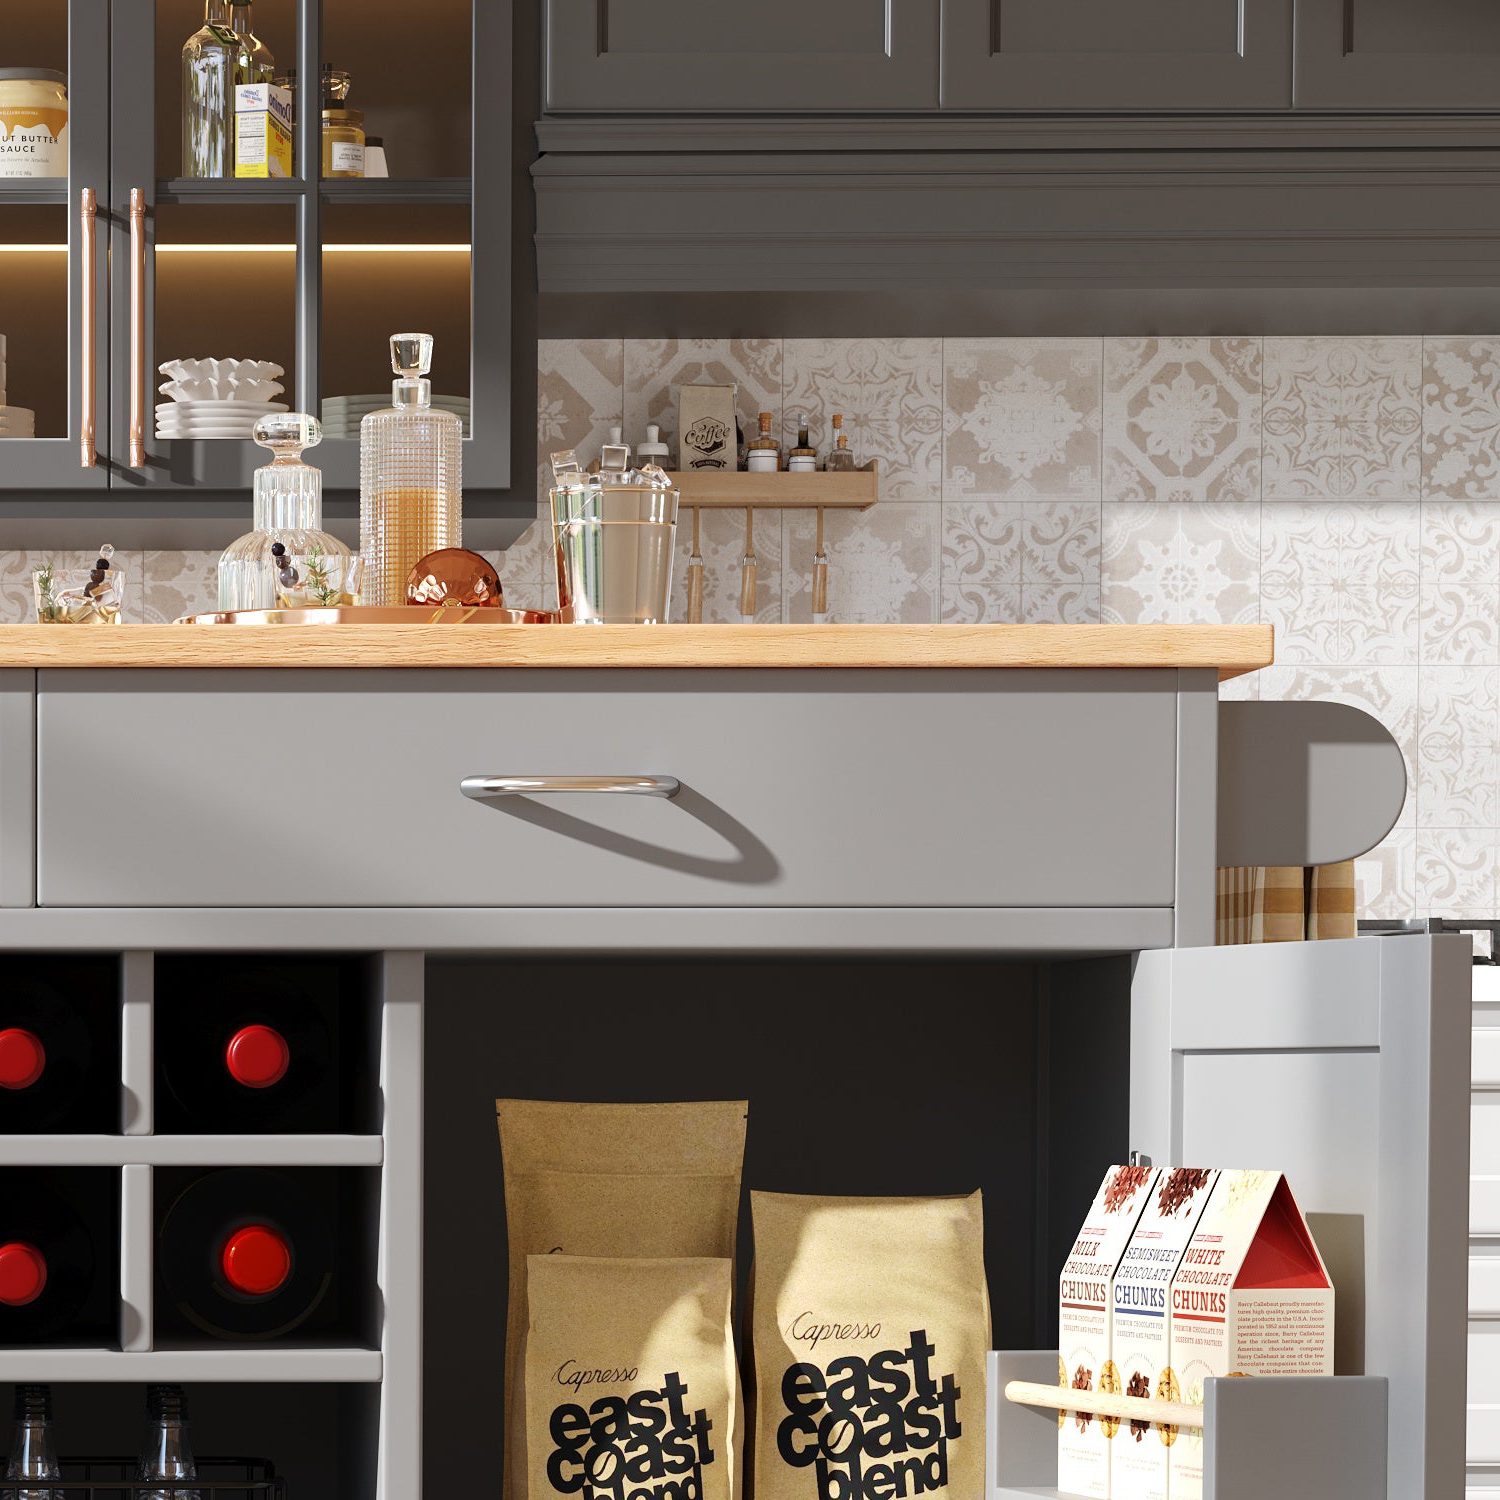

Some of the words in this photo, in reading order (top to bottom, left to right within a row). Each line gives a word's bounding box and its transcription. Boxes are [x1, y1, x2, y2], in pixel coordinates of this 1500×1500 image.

[21, 135, 58, 144] BUTTER
[685, 424, 731, 446] Coffee
[1072, 1241, 1100, 1256] MILK
[1126, 1247, 1180, 1263] SEMISWEET
[1185, 1248, 1226, 1266] WHITE
[1064, 1261, 1112, 1277] CHOCOLATE
[1117, 1265, 1171, 1282] CHOCOLATE
[1175, 1269, 1232, 1286] CHOCOLATE
[1061, 1280, 1106, 1302] CHUNKS
[1115, 1284, 1165, 1308] CHUNKS
[1173, 1290, 1226, 1314] CHUNKS
[1237, 1301, 1252, 1309] Barry
[1280, 1301, 1300, 1309] proudly
[785, 1311, 882, 1350] Capresso
[1174, 1324, 1192, 1333] PREMIUM
[1192, 1326, 1216, 1335] CHOCOLATE
[1175, 1336, 1194, 1344] DESSERTS
[1204, 1338, 1223, 1347] PASTRIES
[551, 1359, 638, 1393] Capresso
[782, 1329, 937, 1417] east
[550, 1371, 691, 1450] east
[776, 1374, 962, 1468] coast
[547, 1408, 714, 1494] coast
